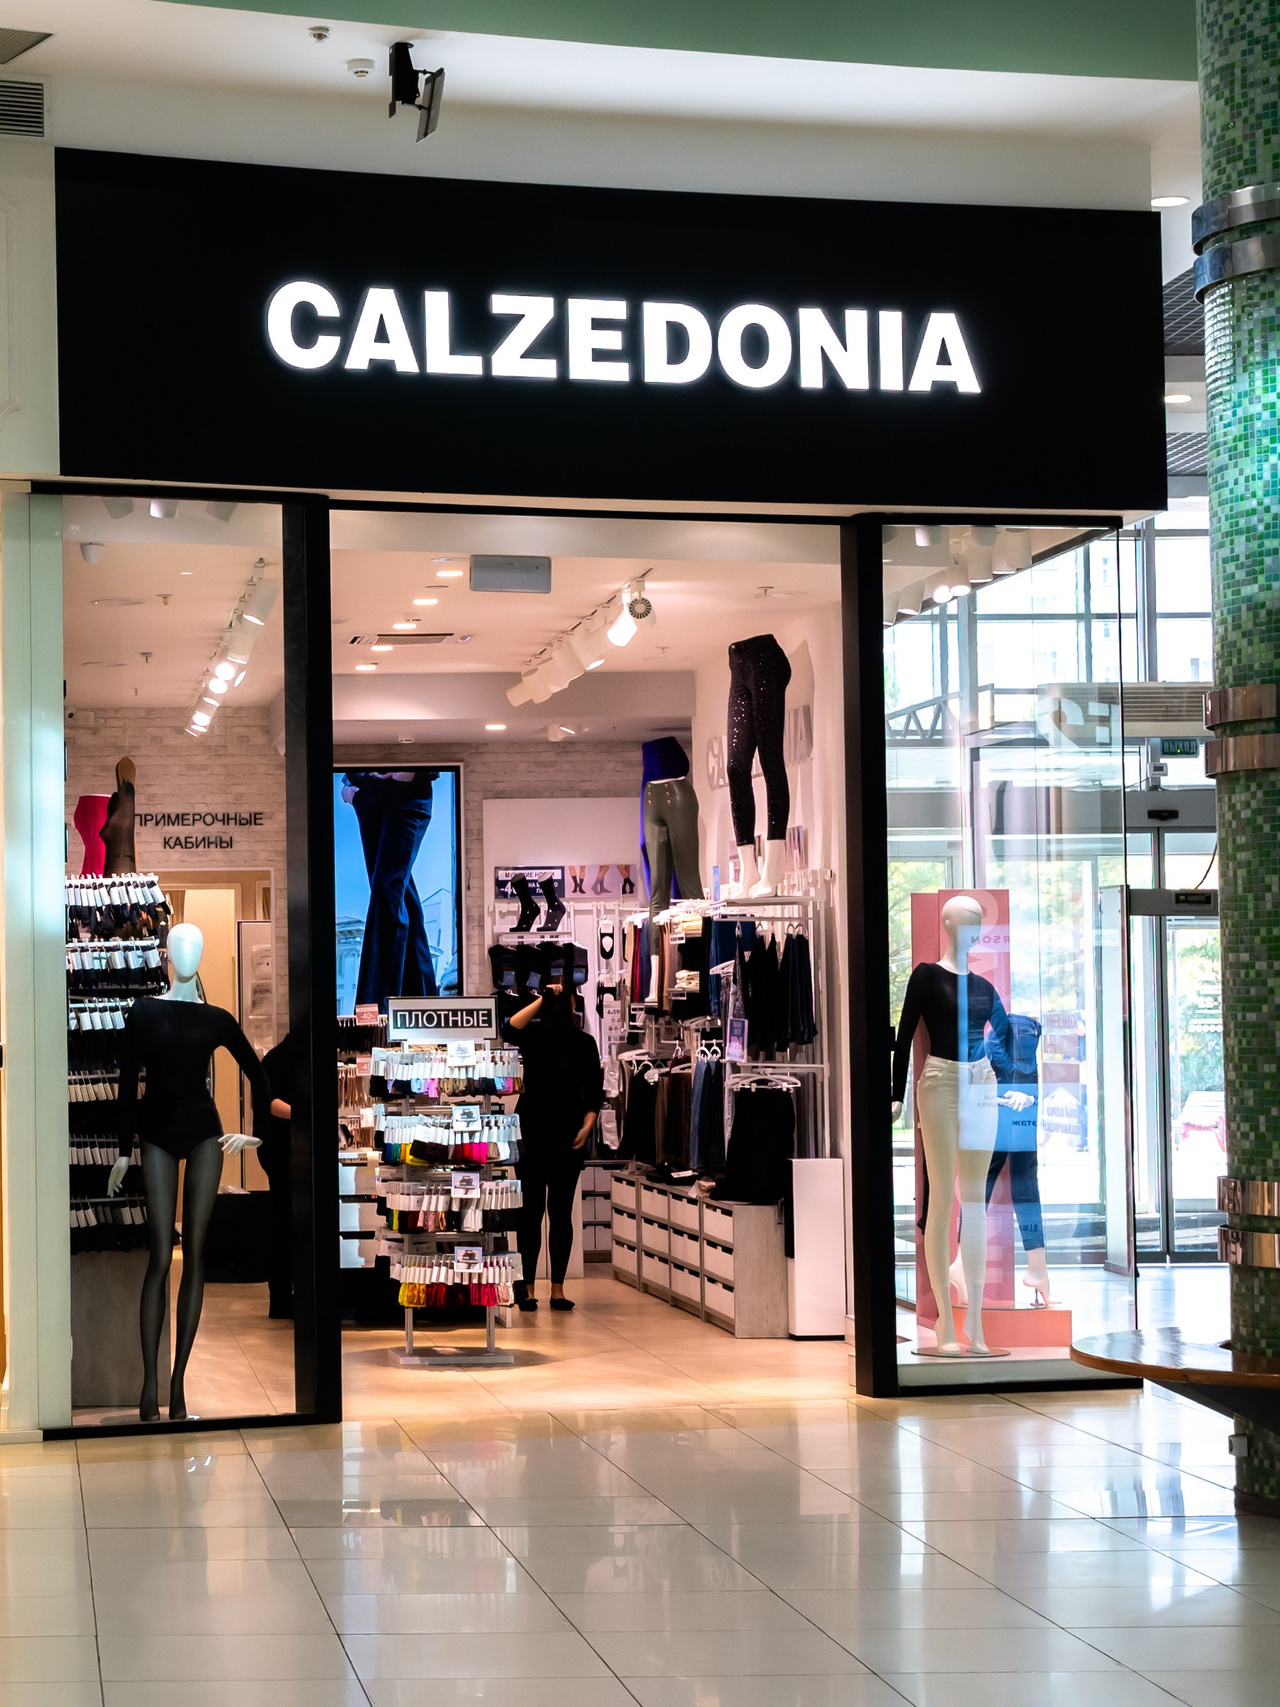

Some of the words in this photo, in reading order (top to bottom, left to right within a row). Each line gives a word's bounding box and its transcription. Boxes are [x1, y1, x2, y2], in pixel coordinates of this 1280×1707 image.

[266, 280, 983, 394] CALZEDONIA
[1163, 741, 1198, 753] ВЫХОД
[134, 812, 264, 827] ПРИМЕРОЧНЫЕ
[163, 836, 233, 849] КАБИНЫ
[397, 1011, 489, 1028] ПЛОТНЫЕ
